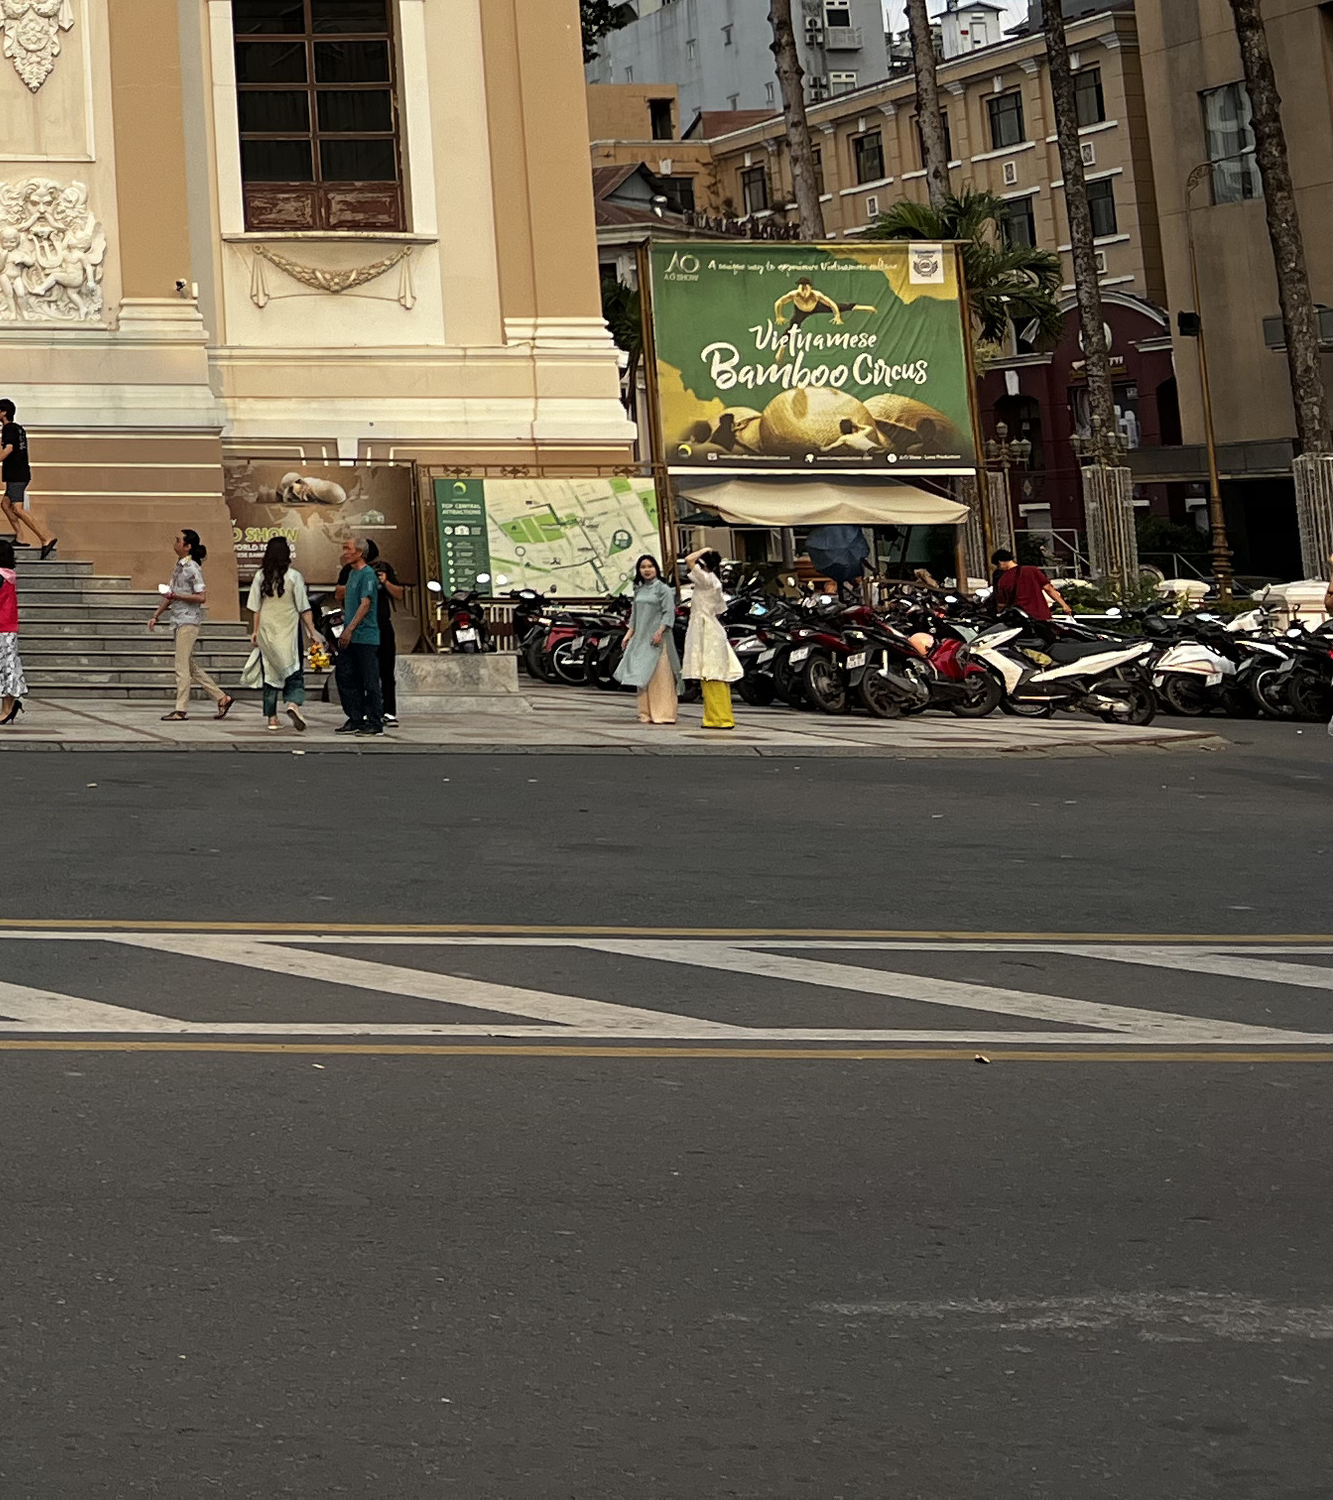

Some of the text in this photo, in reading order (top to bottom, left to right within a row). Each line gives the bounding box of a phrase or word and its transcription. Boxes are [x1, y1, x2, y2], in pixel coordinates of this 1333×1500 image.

[748, 318, 878, 357] Vietnamese
[700, 341, 929, 390] Bamboo Circus
